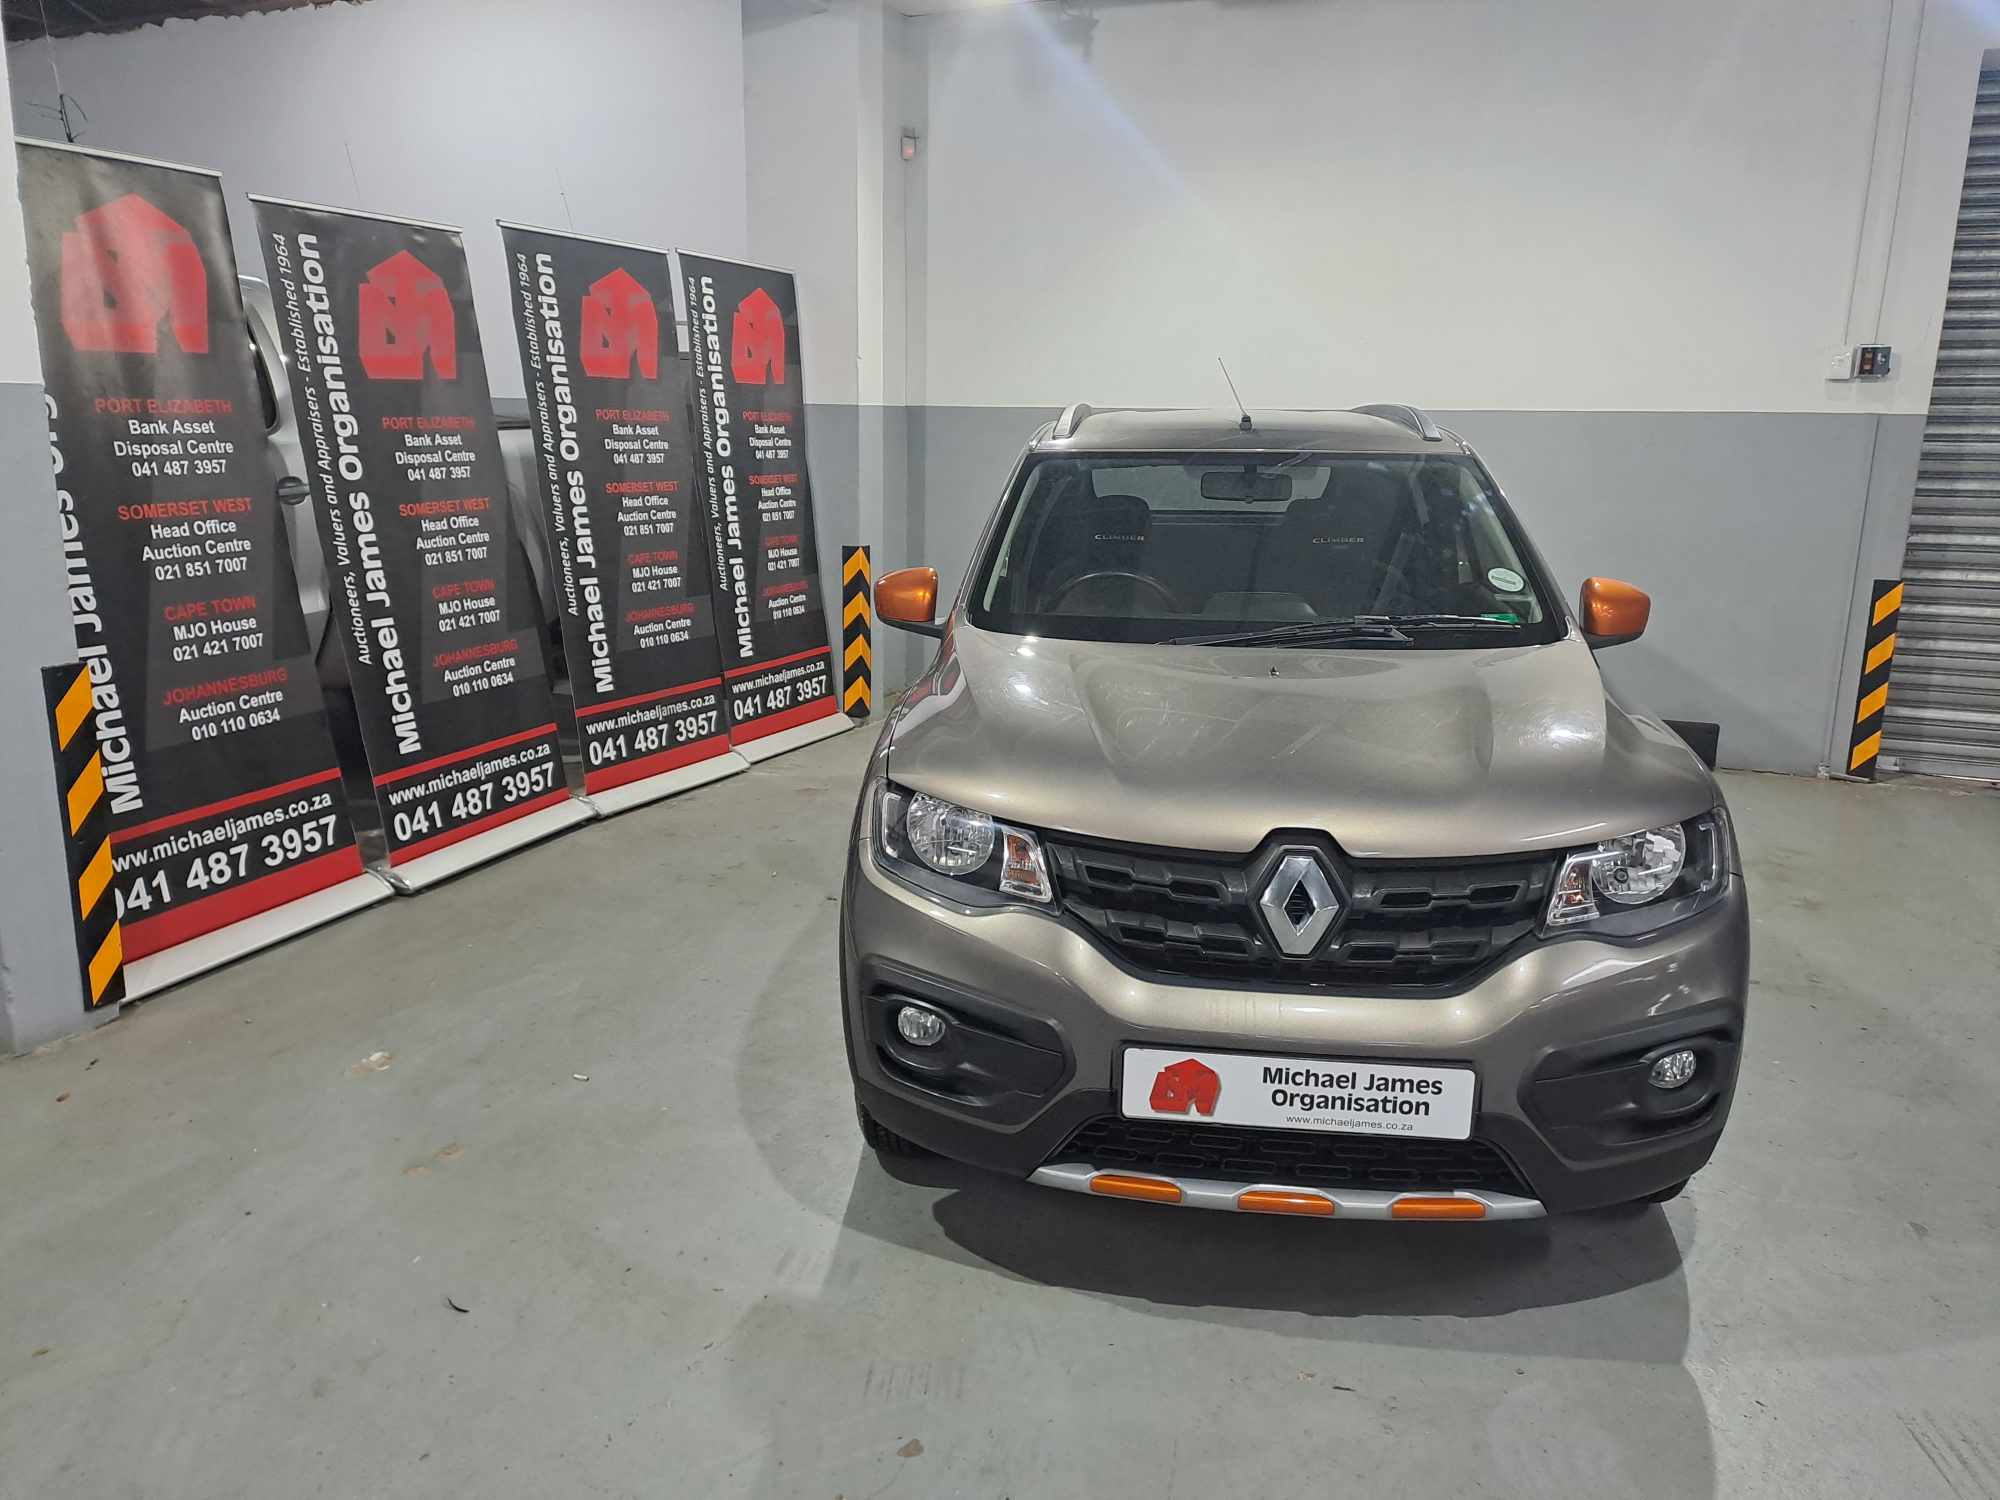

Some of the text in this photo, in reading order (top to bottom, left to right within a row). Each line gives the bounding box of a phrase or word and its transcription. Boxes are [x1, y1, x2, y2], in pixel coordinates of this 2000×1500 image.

[127, 419, 215, 434] Bank Asset
[516, 253, 578, 615] Auctioneers, Valuers and Appraisers Established 1964
[612, 423, 659, 435] Bank Asset
[688, 276, 727, 590] Auctioneers, Valuers and Appraisers Established 1964
[113, 439, 233, 458] Disposal Centre
[272, 233, 371, 664] Auctioneers, Valuers and Appraisers Established 1964
[404, 433, 462, 446] Bank Asset
[604, 438, 668, 451] Disposal Centre
[131, 459, 225, 476] 041 487 3957
[395, 449, 475, 466] Disposal Centre
[613, 453, 627, 464] 041
[700, 276, 753, 657] Michael James Organisation
[407, 465, 470, 480] 041 487 3957
[535, 253, 613, 692] Michael James Organisation
[297, 233, 421, 754] Michael James Organisation
[621, 495, 668, 507] Head Office
[118, 496, 253, 521] SOMERSET WEST
[617, 509, 676, 521] Auction Centre
[150, 519, 236, 538] Head Office
[421, 515, 479, 531] Head Office
[623, 525, 637, 535] 021
[655, 522, 673, 533] 7007
[142, 539, 250, 560] Auction Centre
[416, 531, 489, 549] Auction Centre
[424, 546, 487, 565] 021 851 7007
[154, 556, 246, 580] 021 851 7007
[632, 565, 677, 578] MJO House
[631, 581, 645, 592] 021
[647, 579, 660, 590] 421
[164, 595, 257, 621] CAPE TOWN
[438, 597, 495, 614] MJO House
[173, 617, 256, 640] MJO House
[438, 609, 500, 632] 021 421 7007
[633, 618, 690, 635] Auction Centre
[173, 632, 262, 661] 021 421 7007
[444, 657, 515, 682] Auction Centre
[731, 660, 824, 693] www.michaeljames.co.za
[164, 667, 288, 705] JOHANNESBURG
[452, 671, 513, 696] 010 110 0634
[179, 690, 282, 723] Auction Centre
[733, 674, 826, 720] 041 487 3957
[191, 707, 280, 740] 010 110 0634
[585, 694, 715, 734] www.michaeljames.co.za
[78, 644, 143, 814] Michael
[589, 710, 717, 765] 041 487 3957
[388, 743, 550, 805] www.michaeljames.co.za
[393, 761, 553, 840] 041 487 3957
[186, 843, 248, 889] 487
[261, 814, 336, 866] 3957
[1262, 1066, 1443, 1095] Michael James
[1271, 1088, 1430, 1116] Organisation
[1285, 1115, 1414, 1132] www.michaeljames.co.za
